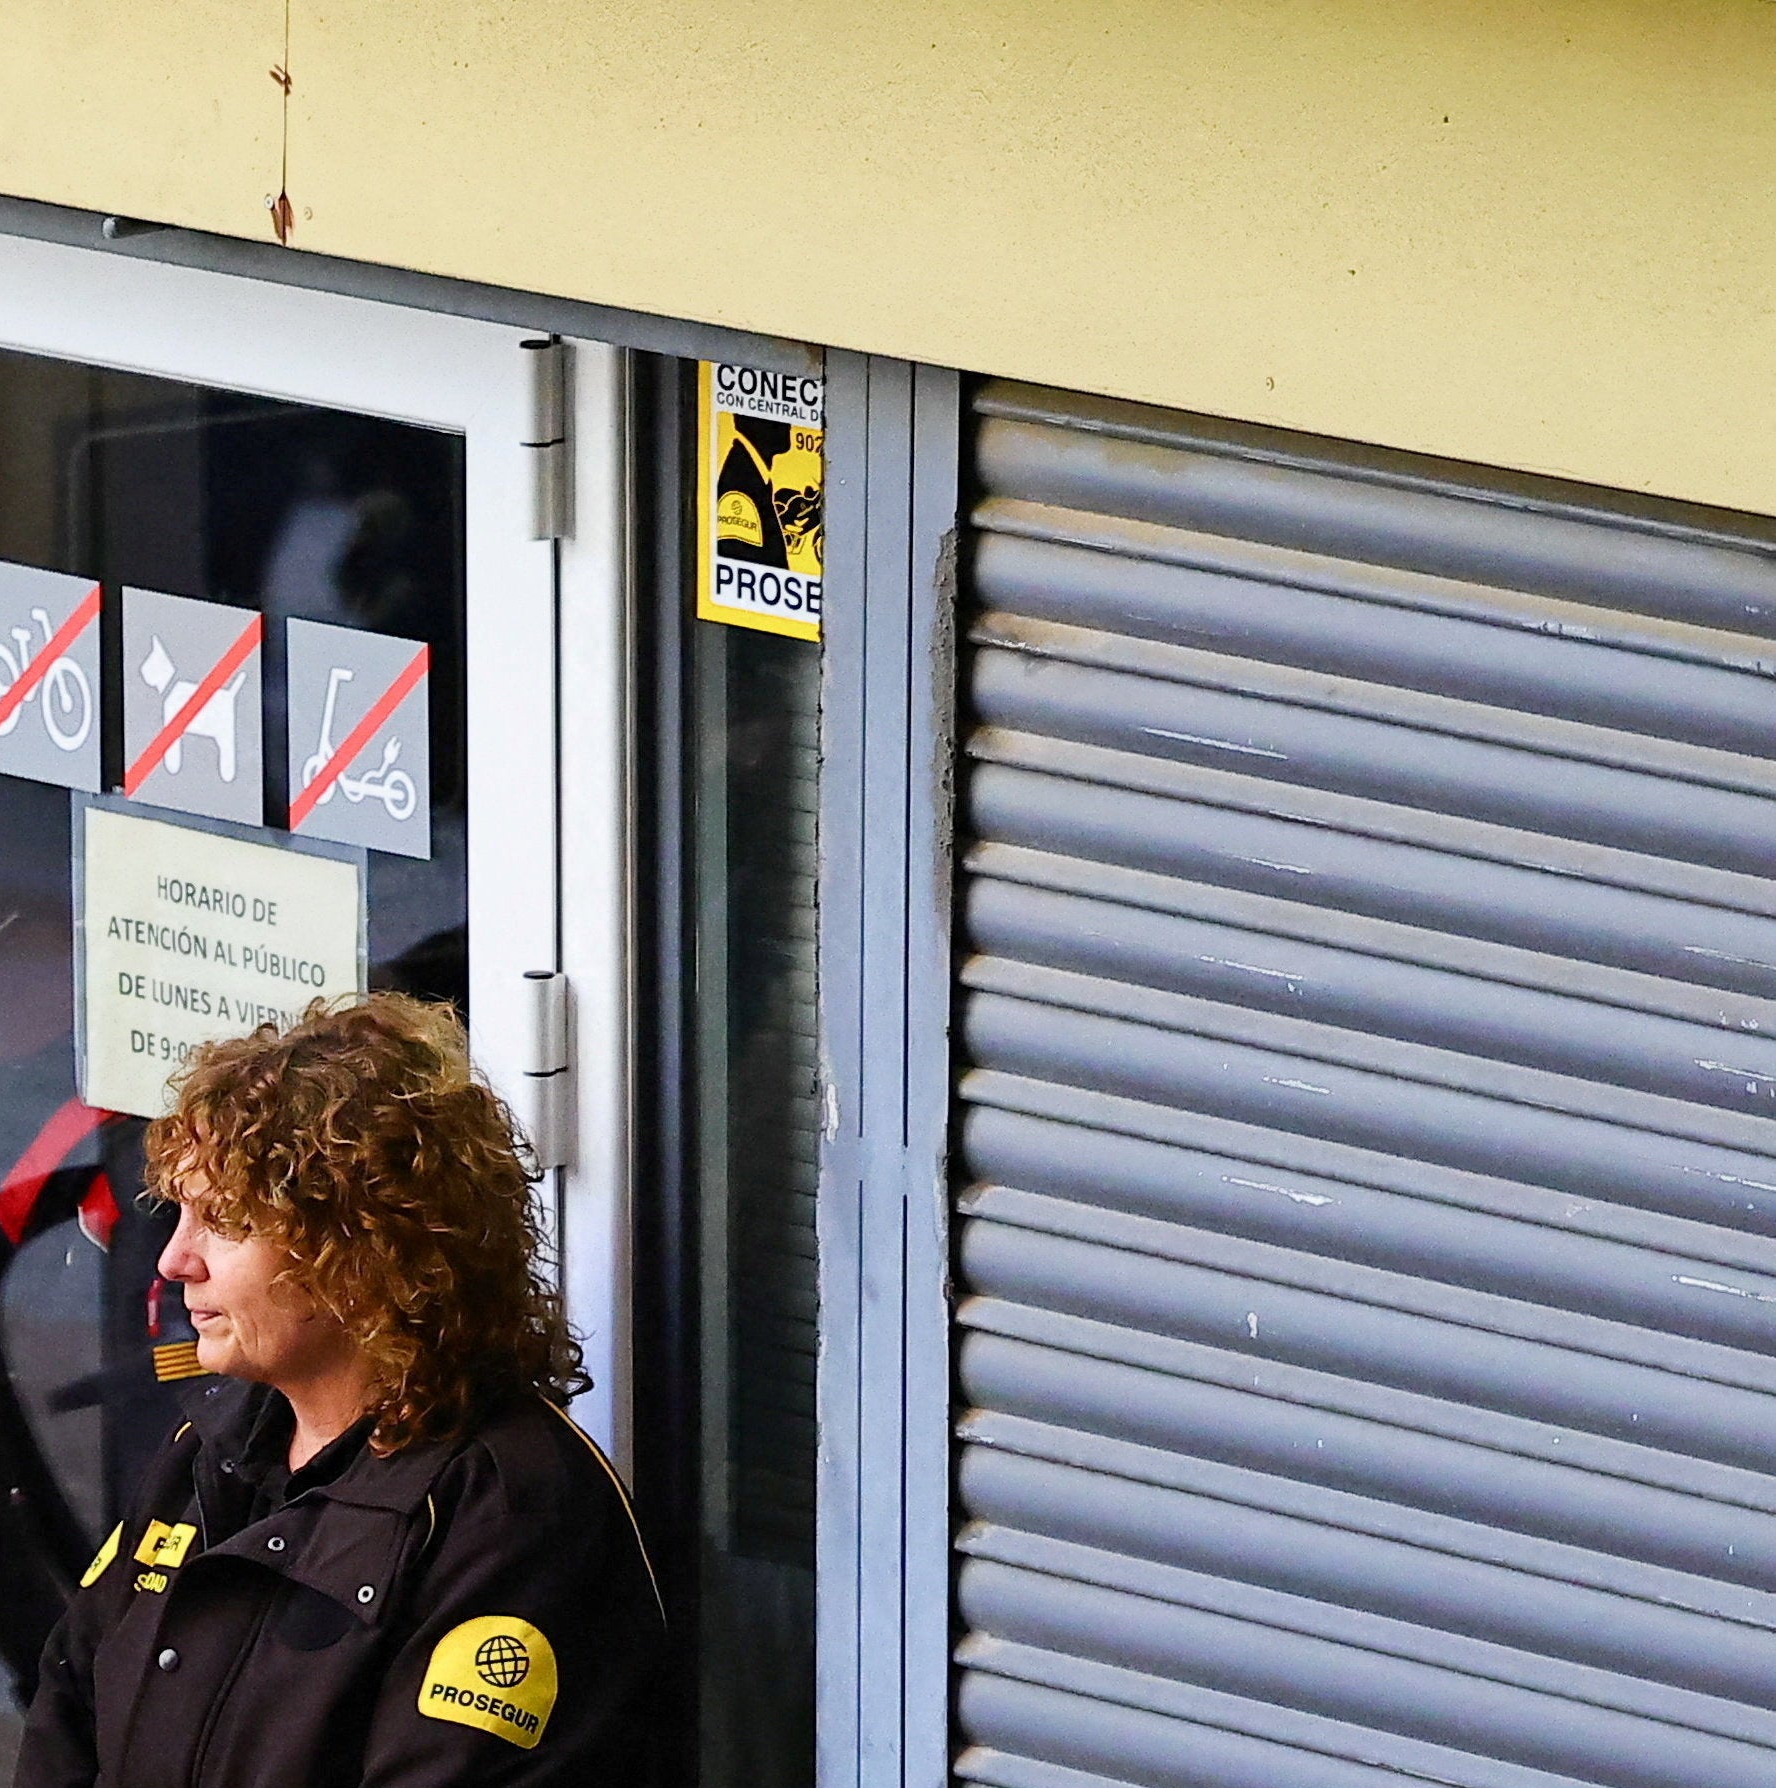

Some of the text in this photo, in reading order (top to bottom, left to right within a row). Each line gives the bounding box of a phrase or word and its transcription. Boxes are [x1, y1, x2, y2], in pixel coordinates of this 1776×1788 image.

[716, 391, 744, 408] CON
[748, 398, 806, 420] CENTRAL
[717, 363, 818, 406] CONEC
[716, 563, 821, 615] PROSE
[157, 875, 277, 926] HORARIO DE
[108, 916, 325, 987] ATENCIÓN AL PÚBLICO
[119, 972, 145, 999] DE
[152, 978, 211, 1015] LUNES
[217, 996, 230, 1021] A
[131, 1030, 155, 1057] DE
[429, 1682, 539, 1735] PROSEGUR
